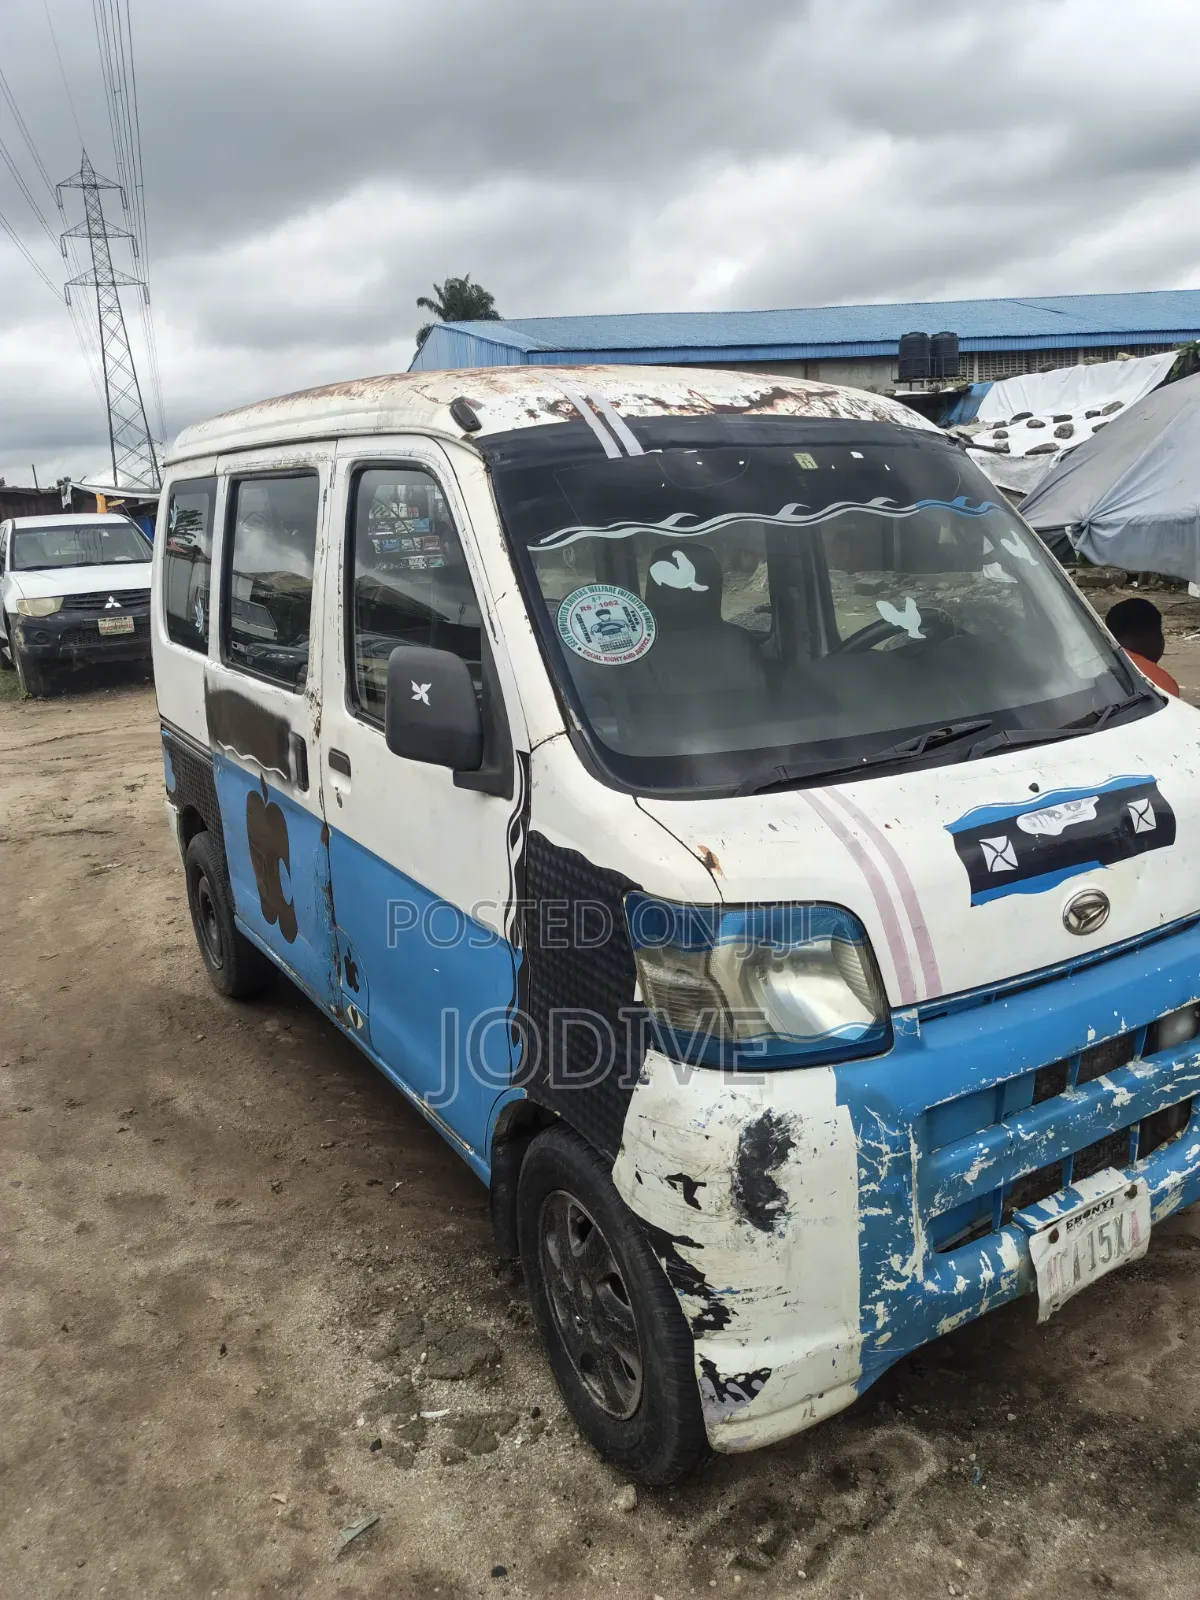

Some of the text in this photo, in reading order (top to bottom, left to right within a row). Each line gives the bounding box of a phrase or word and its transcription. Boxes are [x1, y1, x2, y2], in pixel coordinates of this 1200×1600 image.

[564, 588, 588, 608] DRIVERS
[587, 585, 617, 594] WELFARE
[617, 588, 648, 612] INITIATIVE
[579, 604, 592, 612] RS
[559, 606, 570, 636] EMPLOYED
[563, 634, 579, 648] SELF
[583, 649, 603, 661] EQUAL
[622, 652, 636, 661] AND
[635, 637, 651, 655] JUSTICE
[1065, 1197, 1115, 1230] EBONYI
